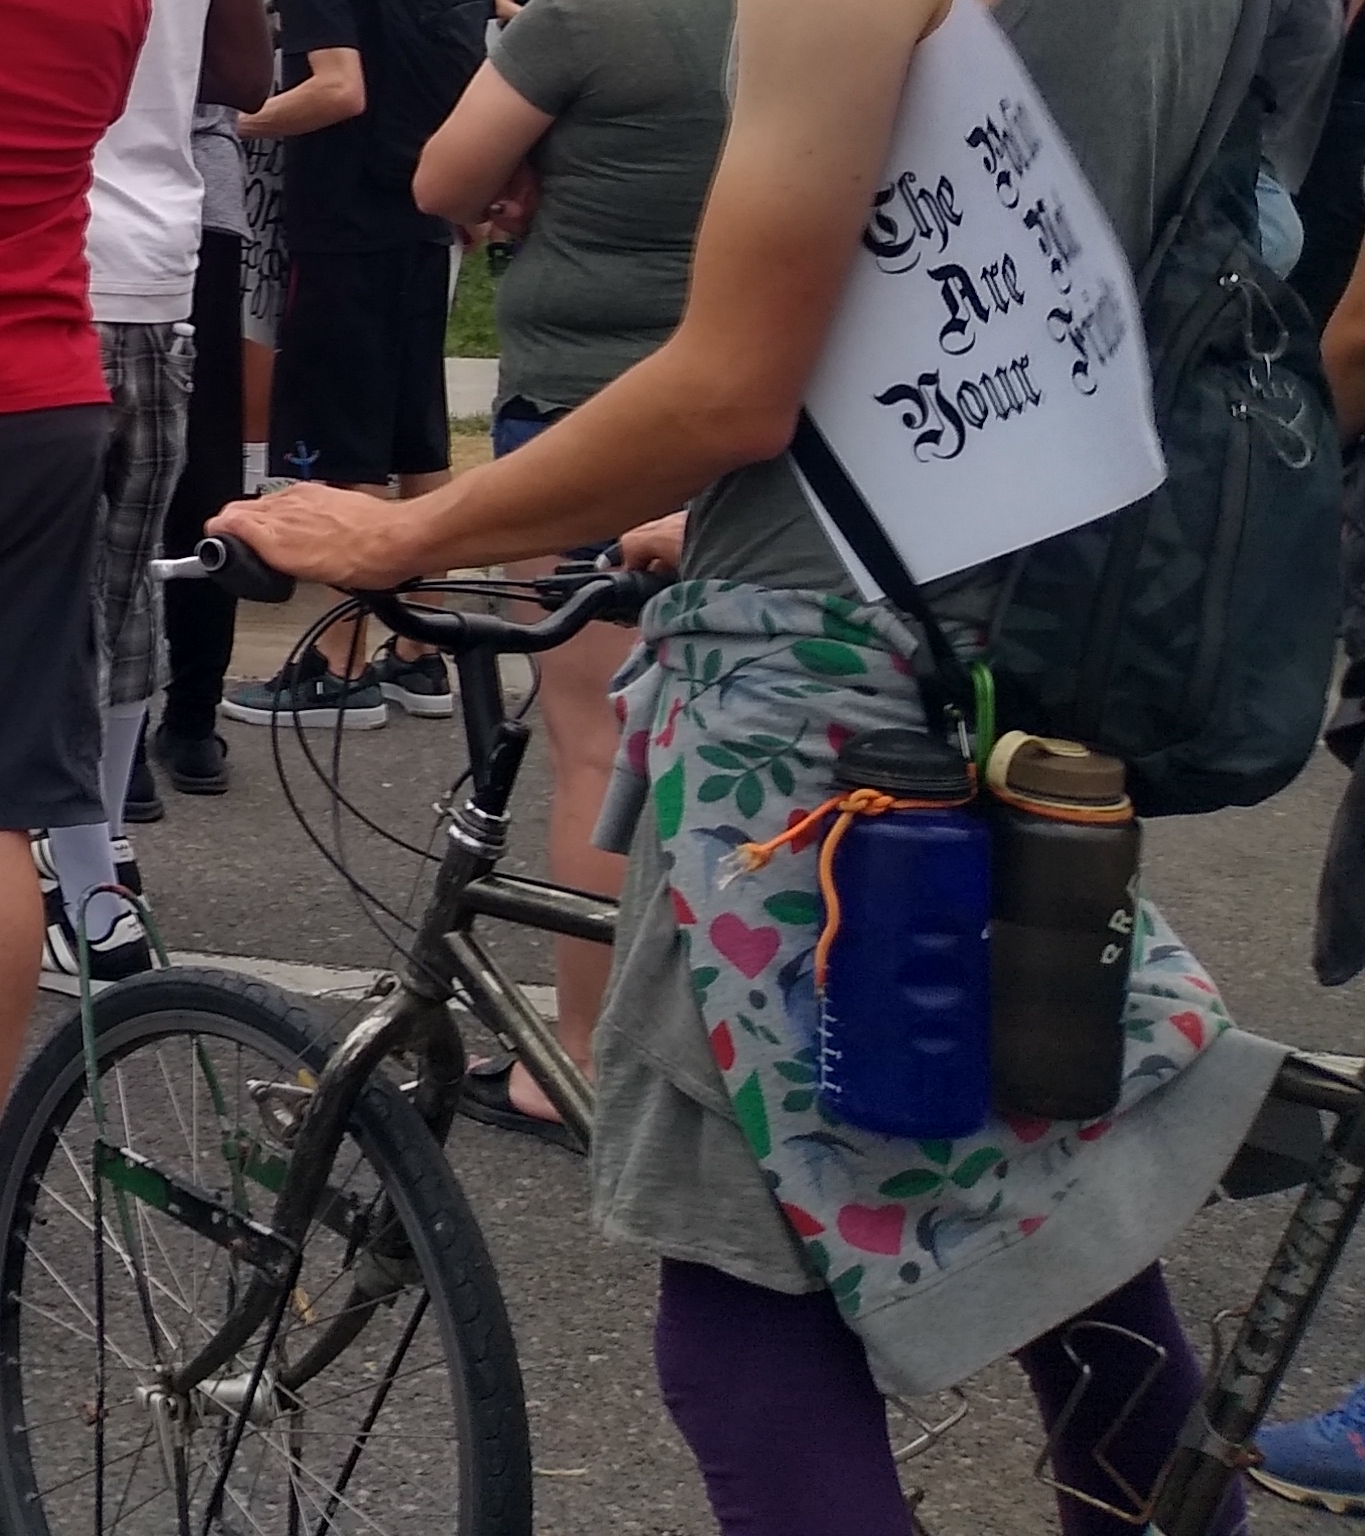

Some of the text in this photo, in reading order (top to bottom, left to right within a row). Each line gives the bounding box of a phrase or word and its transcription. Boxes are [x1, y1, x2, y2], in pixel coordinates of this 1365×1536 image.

[863, 171, 964, 273] The
[926, 252, 1026, 355] Are
[873, 353, 1042, 463] Your
